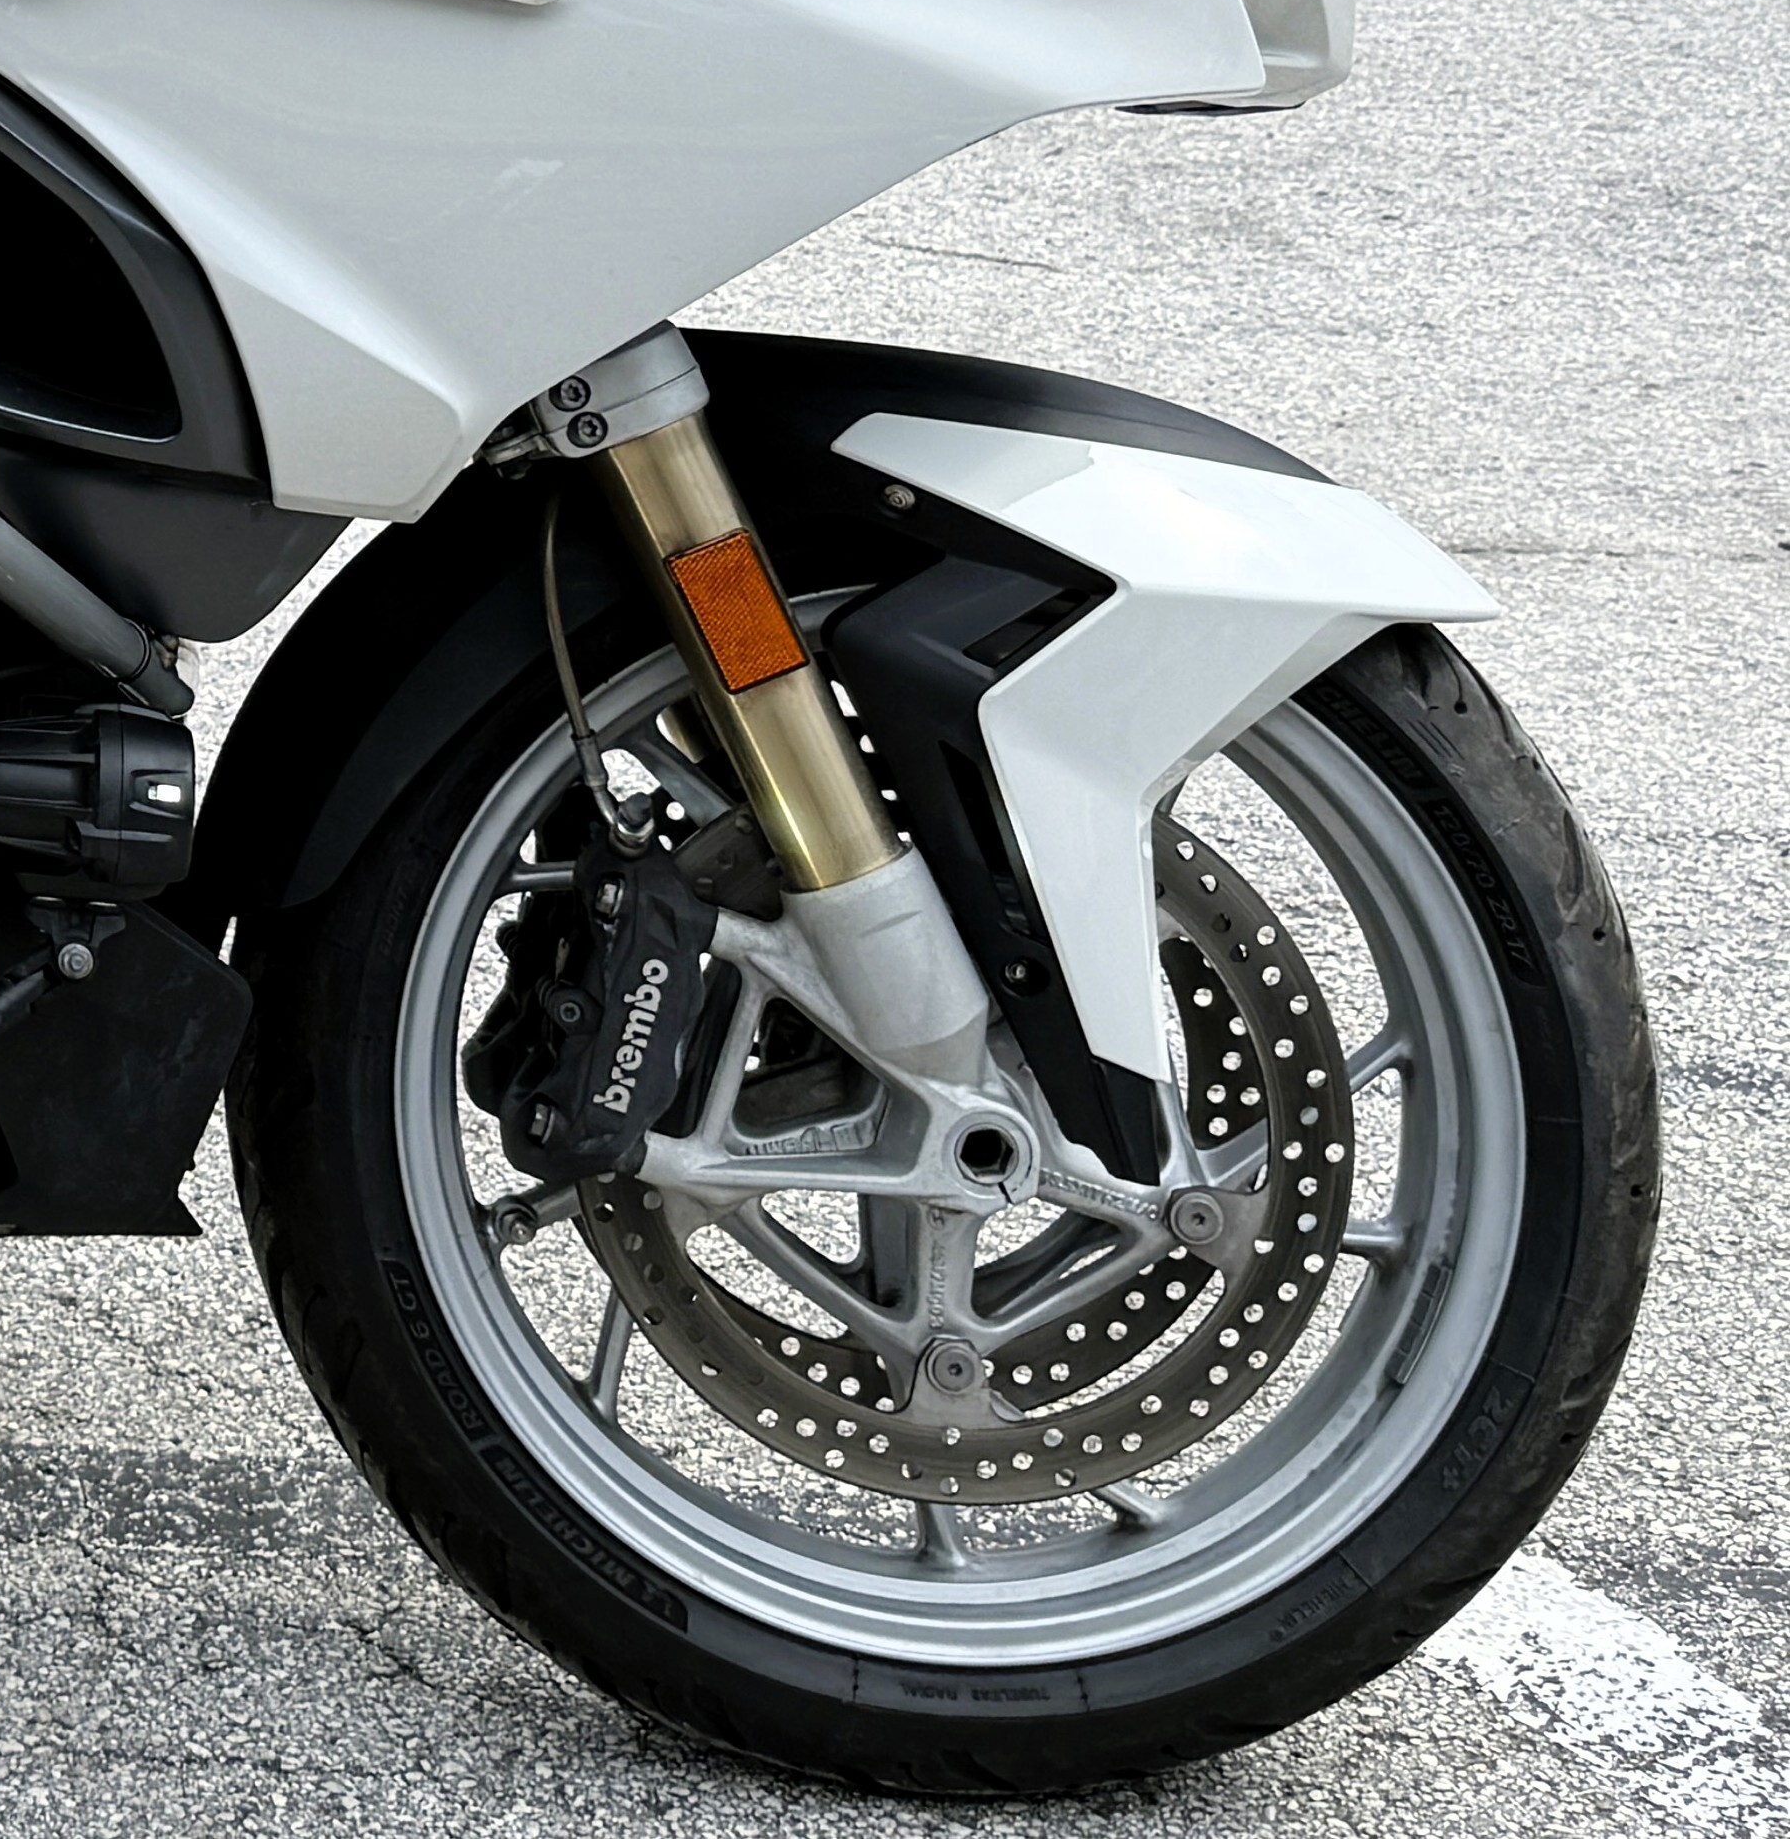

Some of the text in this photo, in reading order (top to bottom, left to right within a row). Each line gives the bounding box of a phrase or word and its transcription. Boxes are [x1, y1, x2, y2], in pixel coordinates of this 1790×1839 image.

[1311, 681, 1428, 786] CHELIN
[593, 957, 669, 1115] brembo
[389, 1272, 636, 1588] MICHELIN ROAD 6 GT
